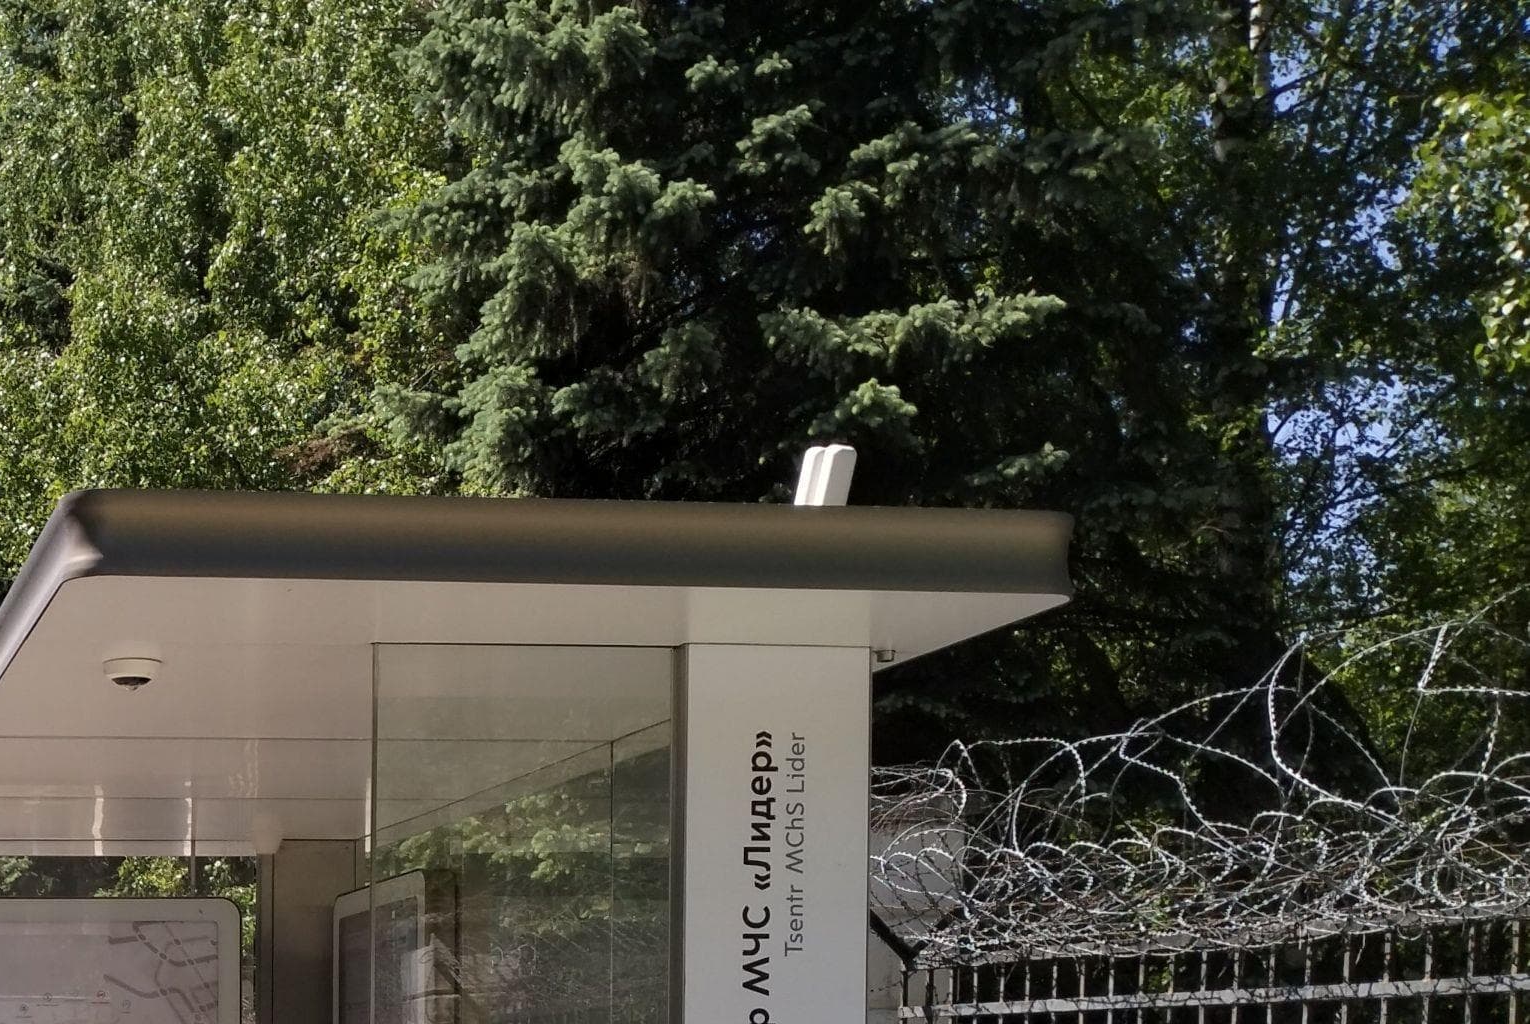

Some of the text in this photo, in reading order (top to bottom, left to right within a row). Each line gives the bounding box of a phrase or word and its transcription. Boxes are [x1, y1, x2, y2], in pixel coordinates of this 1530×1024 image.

[742, 730, 778, 890] «Лидер»
[784, 732, 806, 957] Tsentr MChS Lider
[741, 904, 772, 996] МЧС
